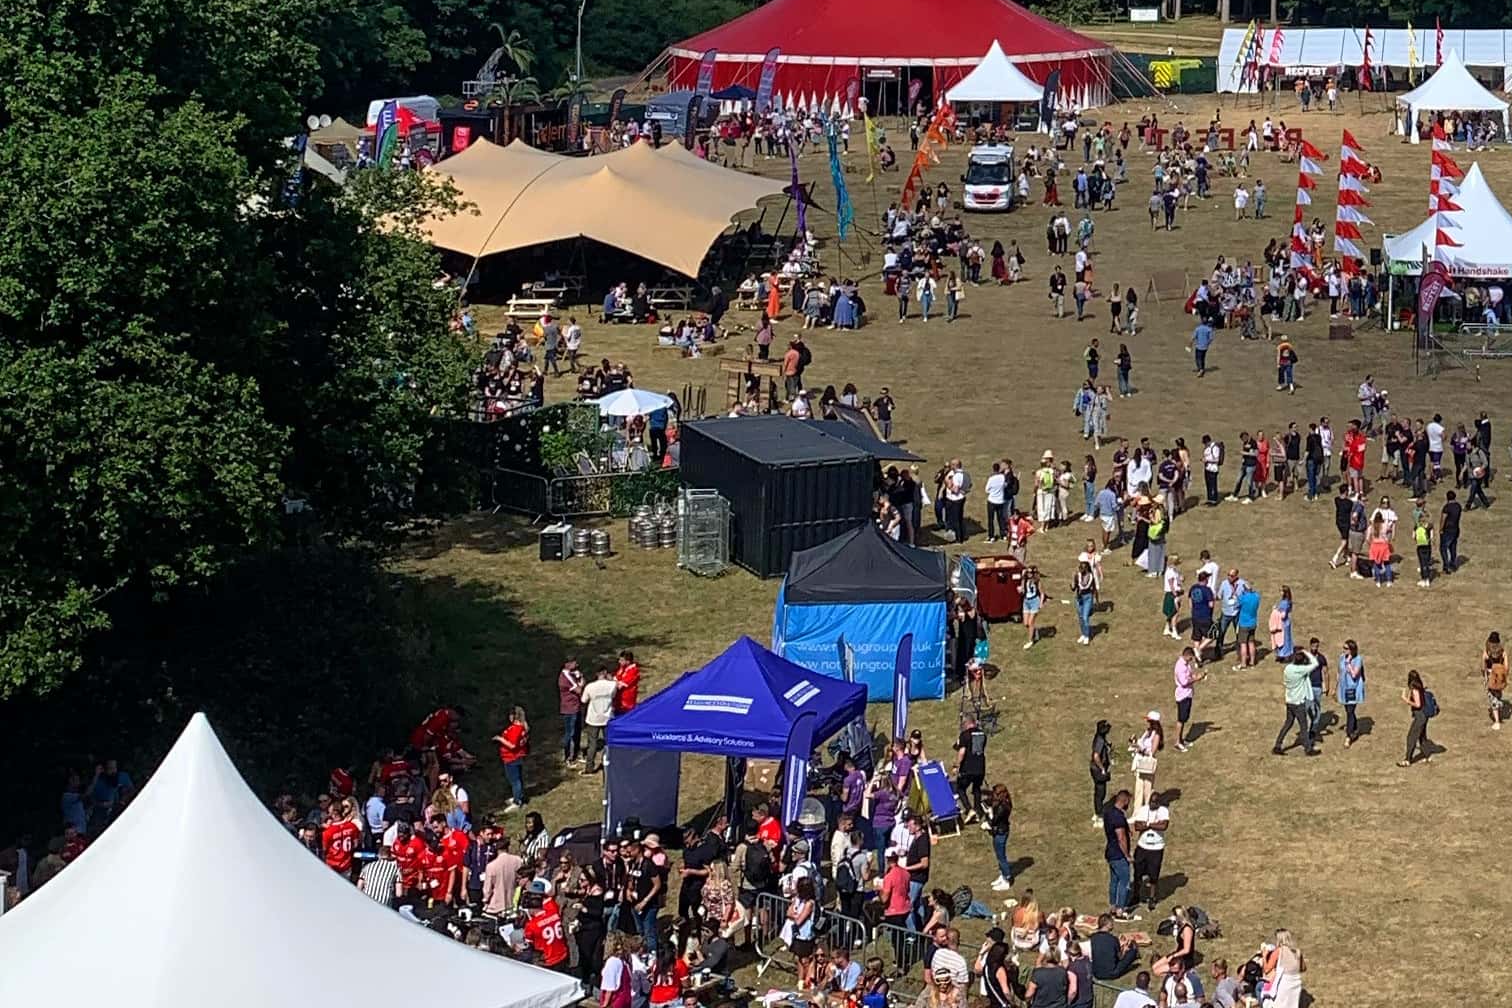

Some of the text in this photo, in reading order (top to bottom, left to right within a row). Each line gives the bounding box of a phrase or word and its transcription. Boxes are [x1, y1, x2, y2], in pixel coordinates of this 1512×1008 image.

[1284, 66, 1328, 77] RECFEST
[1457, 266, 1509, 276] Handshake
[693, 735, 723, 746] Advisory
[723, 737, 756, 748] Solutions
[541, 921, 563, 945] 96
